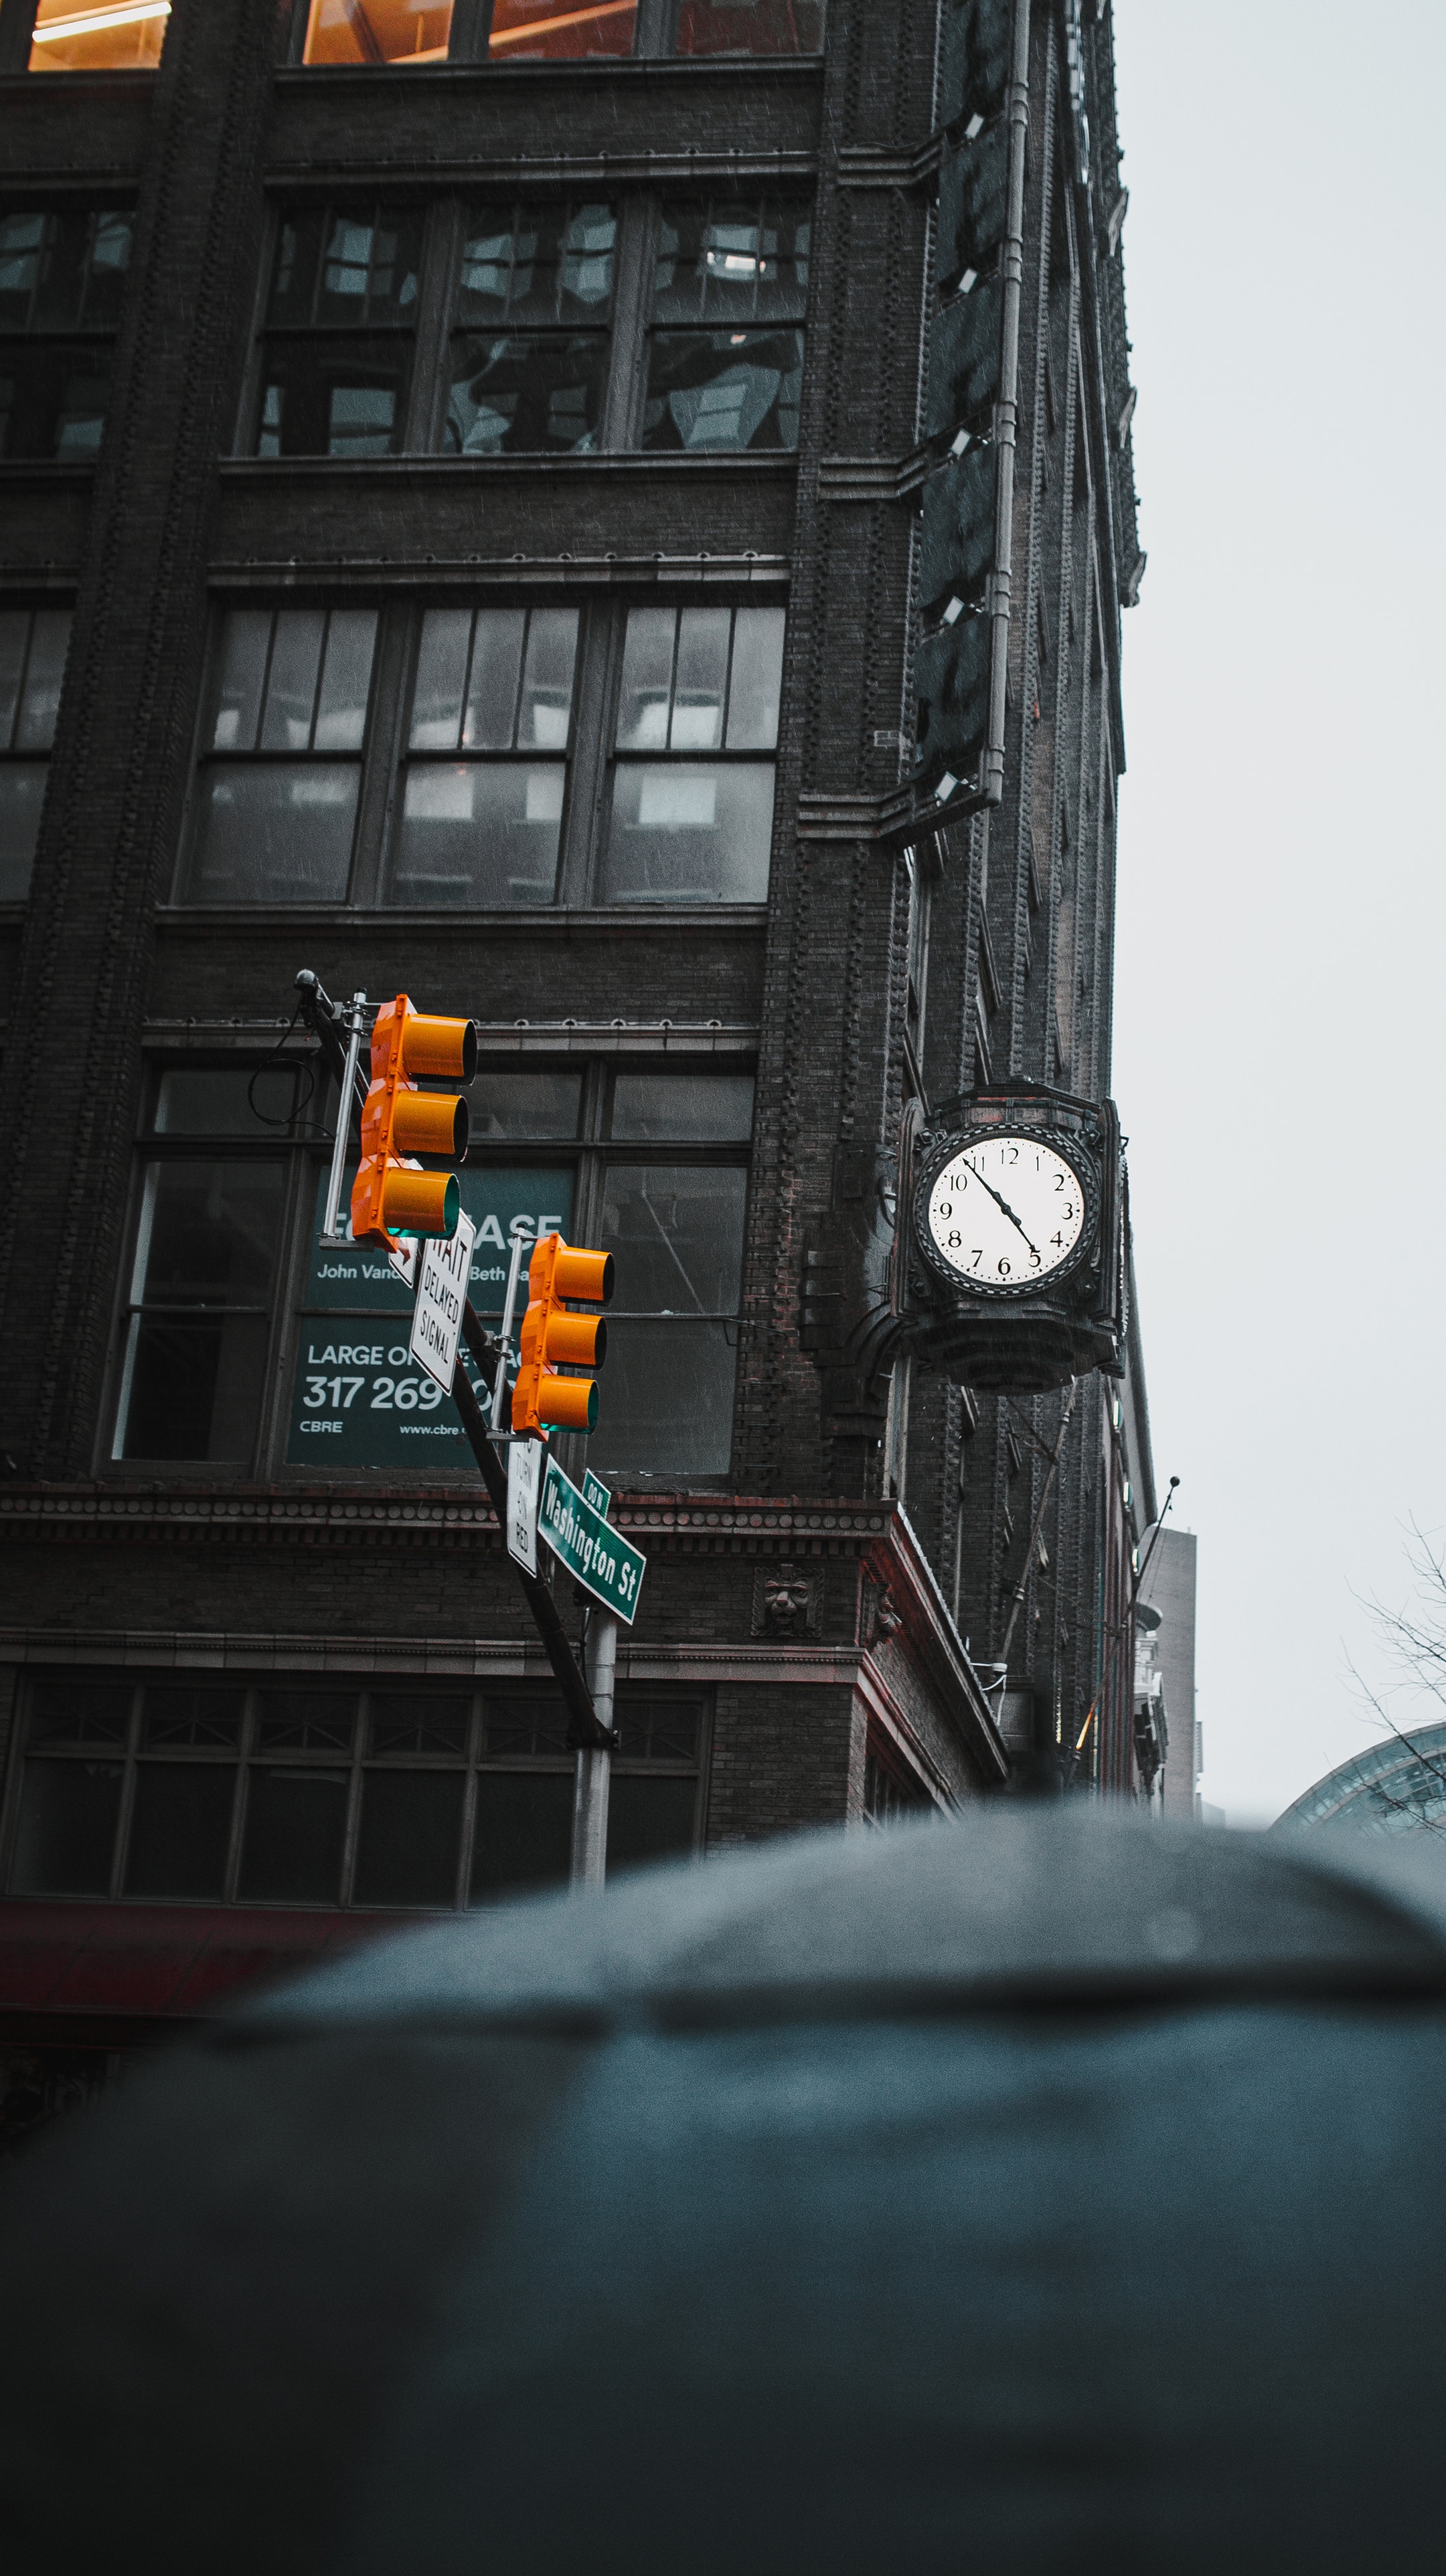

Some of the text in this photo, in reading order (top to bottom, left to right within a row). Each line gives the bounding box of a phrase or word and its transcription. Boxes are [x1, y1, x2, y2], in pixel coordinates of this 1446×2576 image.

[1001, 1147, 1019, 1165] 12
[950, 1174, 968, 1192] 10
[1052, 1174, 1064, 1192] 2
[939, 1202, 953, 1220] 9
[1060, 1202, 1073, 1220] 3
[948, 1230, 962, 1248] 8
[1049, 1230, 1064, 1248] 4
[971, 1249, 983, 1268] 7
[997, 1257, 1012, 1275] 6
[317, 1264, 357, 1279] John
[470, 1266, 505, 1281] Beth
[424, 1264, 459, 1324] DELAYED
[420, 1309, 449, 1365] SIGNAL
[308, 1345, 384, 1365] LARGE
[303, 1376, 366, 1408] 317
[370, 1377, 443, 1411] 269
[300, 1421, 343, 1433] CBRE
[516, 1521, 528, 1554] RED
[545, 1479, 637, 1601] Washington St
